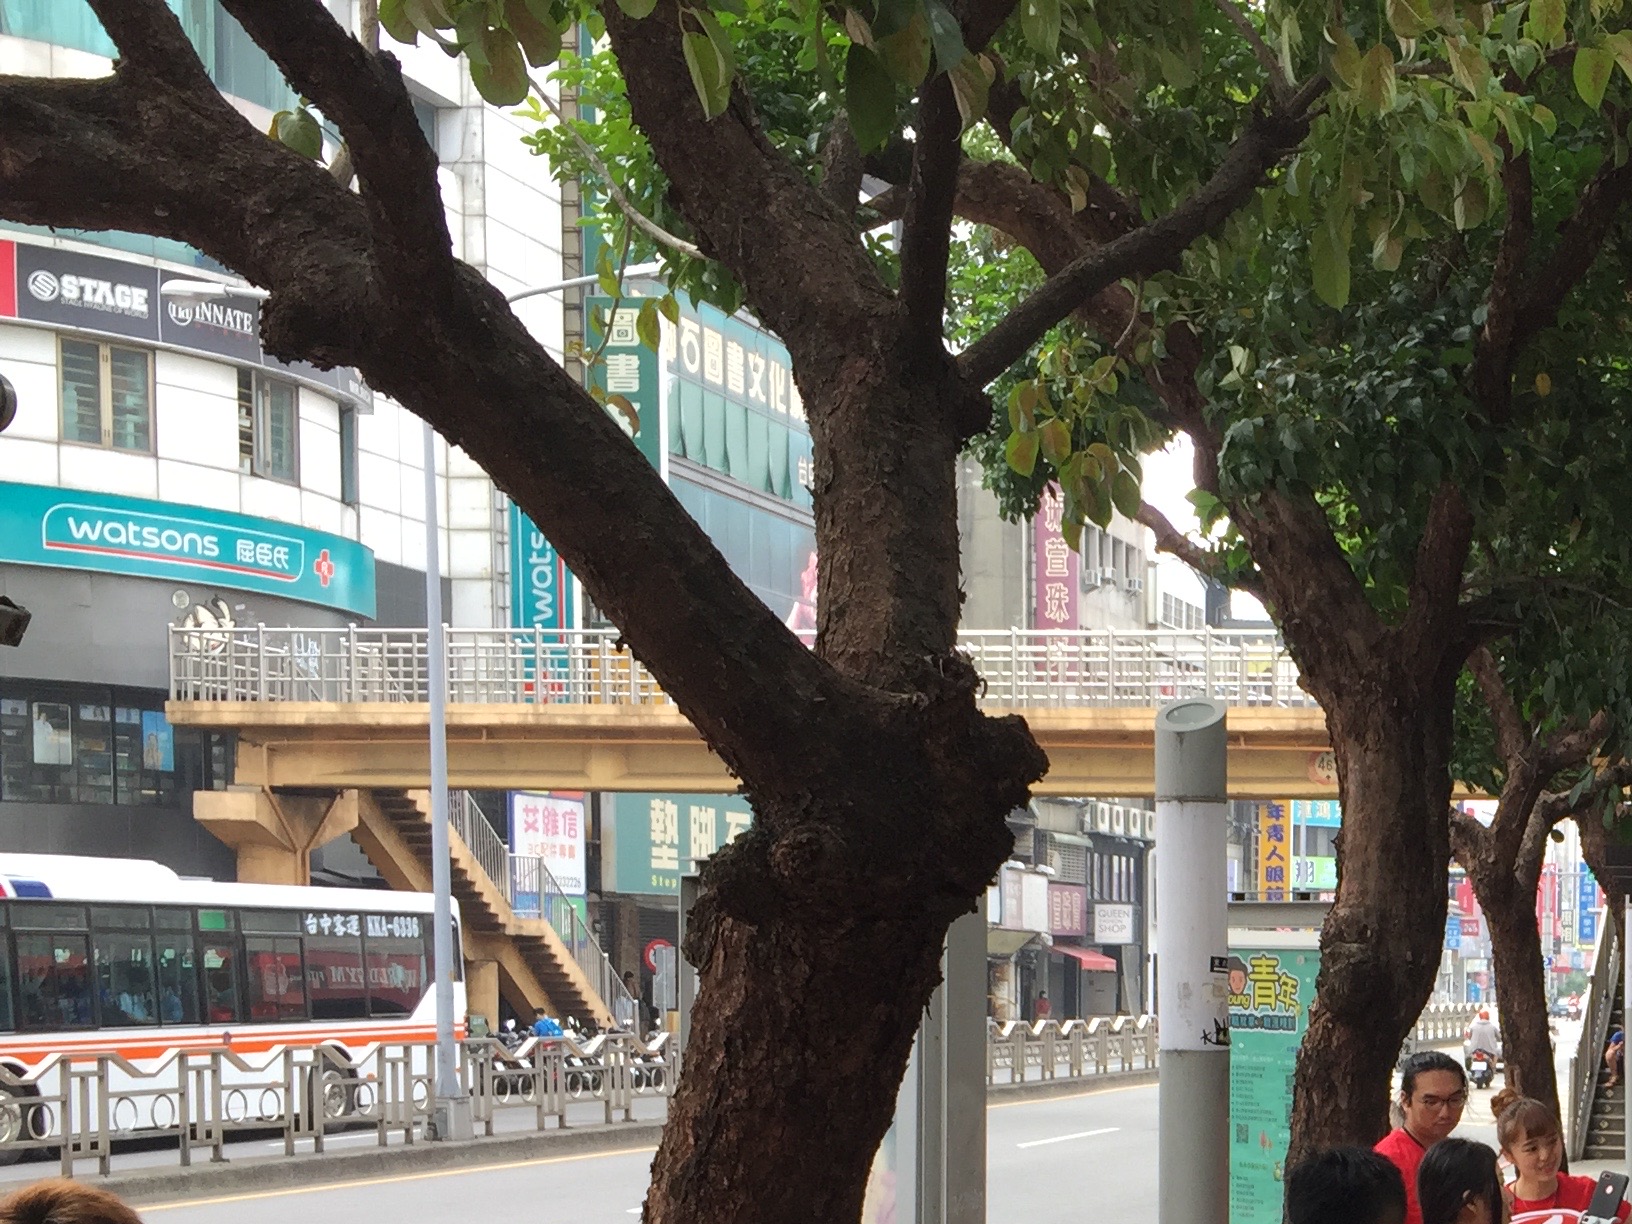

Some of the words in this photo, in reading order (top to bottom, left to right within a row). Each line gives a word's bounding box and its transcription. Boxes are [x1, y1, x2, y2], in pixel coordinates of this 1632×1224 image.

[60, 273, 149, 312] STAGE
[195, 301, 253, 333] INNATE
[605, 308, 642, 438] 圖書
[67, 516, 219, 557] watsons
[236, 538, 289, 570] 屈臣氏
[529, 519, 554, 623] wats
[306, 912, 361, 936] 台中客運
[1098, 909, 1130, 919] QUEEN
[1098, 924, 1127, 933] SHOP
[1248, 953, 1299, 1012] 青年
[1227, 994, 1251, 1010] oung
